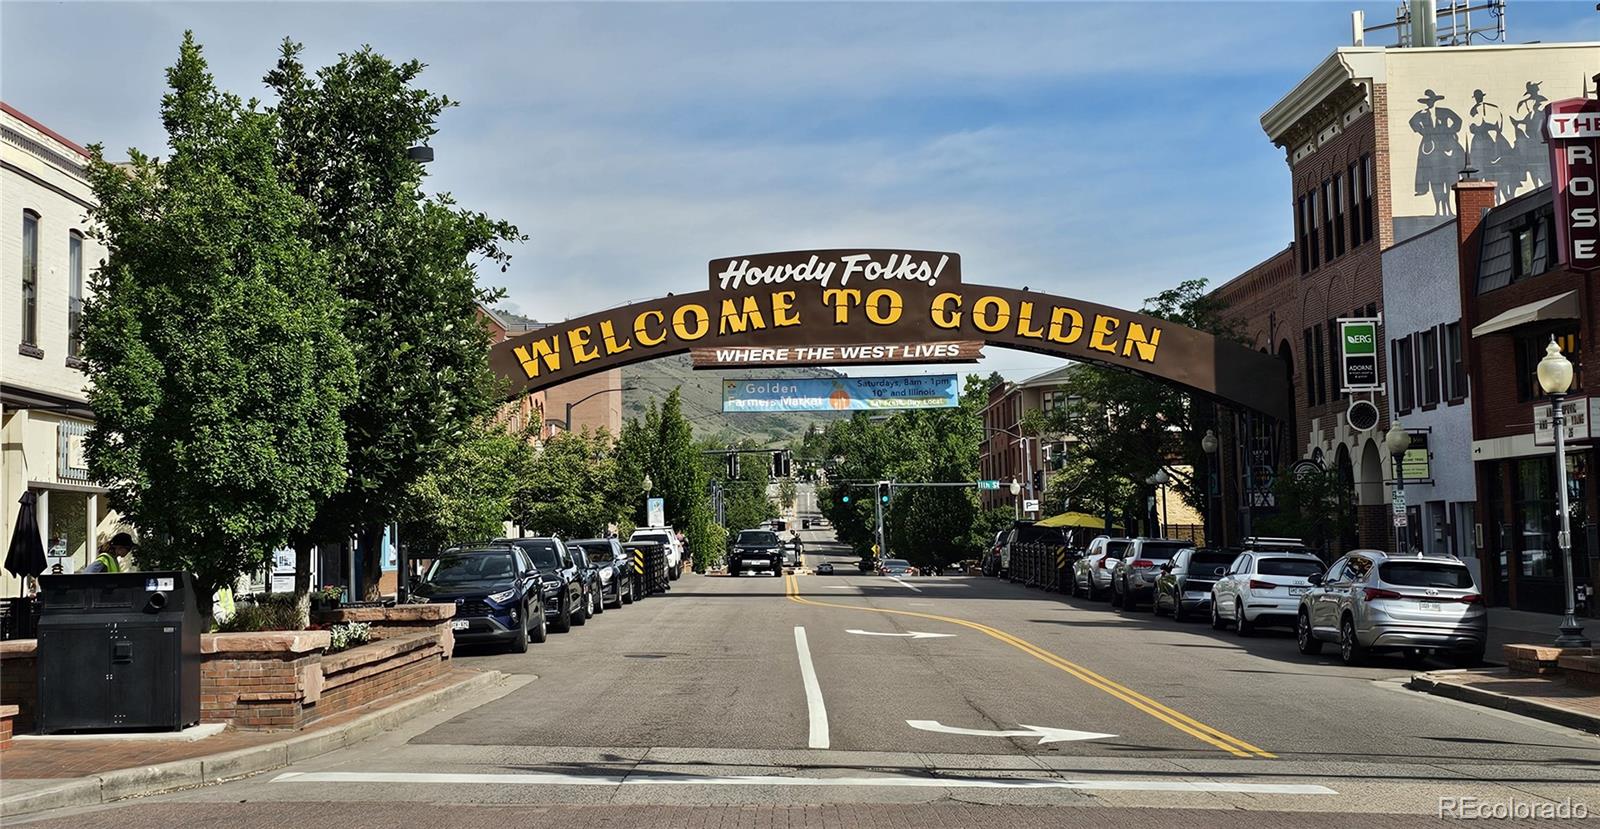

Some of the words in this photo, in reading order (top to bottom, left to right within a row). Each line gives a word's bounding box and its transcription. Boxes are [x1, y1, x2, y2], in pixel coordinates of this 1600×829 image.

[1567, 145, 1598, 259] ROSE
[718, 254, 837, 290] Howdy
[840, 253, 949, 287] Folks!
[512, 290, 801, 379] WELCOME
[822, 288, 903, 325] TO
[930, 292, 1162, 363] GOLDEN
[1354, 334, 1372, 344] ERG
[716, 347, 788, 362] WHERE
[794, 347, 836, 360] THE
[840, 346, 899, 359] WEST
[903, 344, 960, 358] LIVES
[745, 383, 797, 393] Golden
[857, 379, 901, 389] Saturdays,
[931, 378, 949, 386] 1pm
[891, 389, 906, 397] and
[908, 388, 936, 397] Illinois
[780, 394, 823, 407] Market
[992, 480, 1000, 489] St
